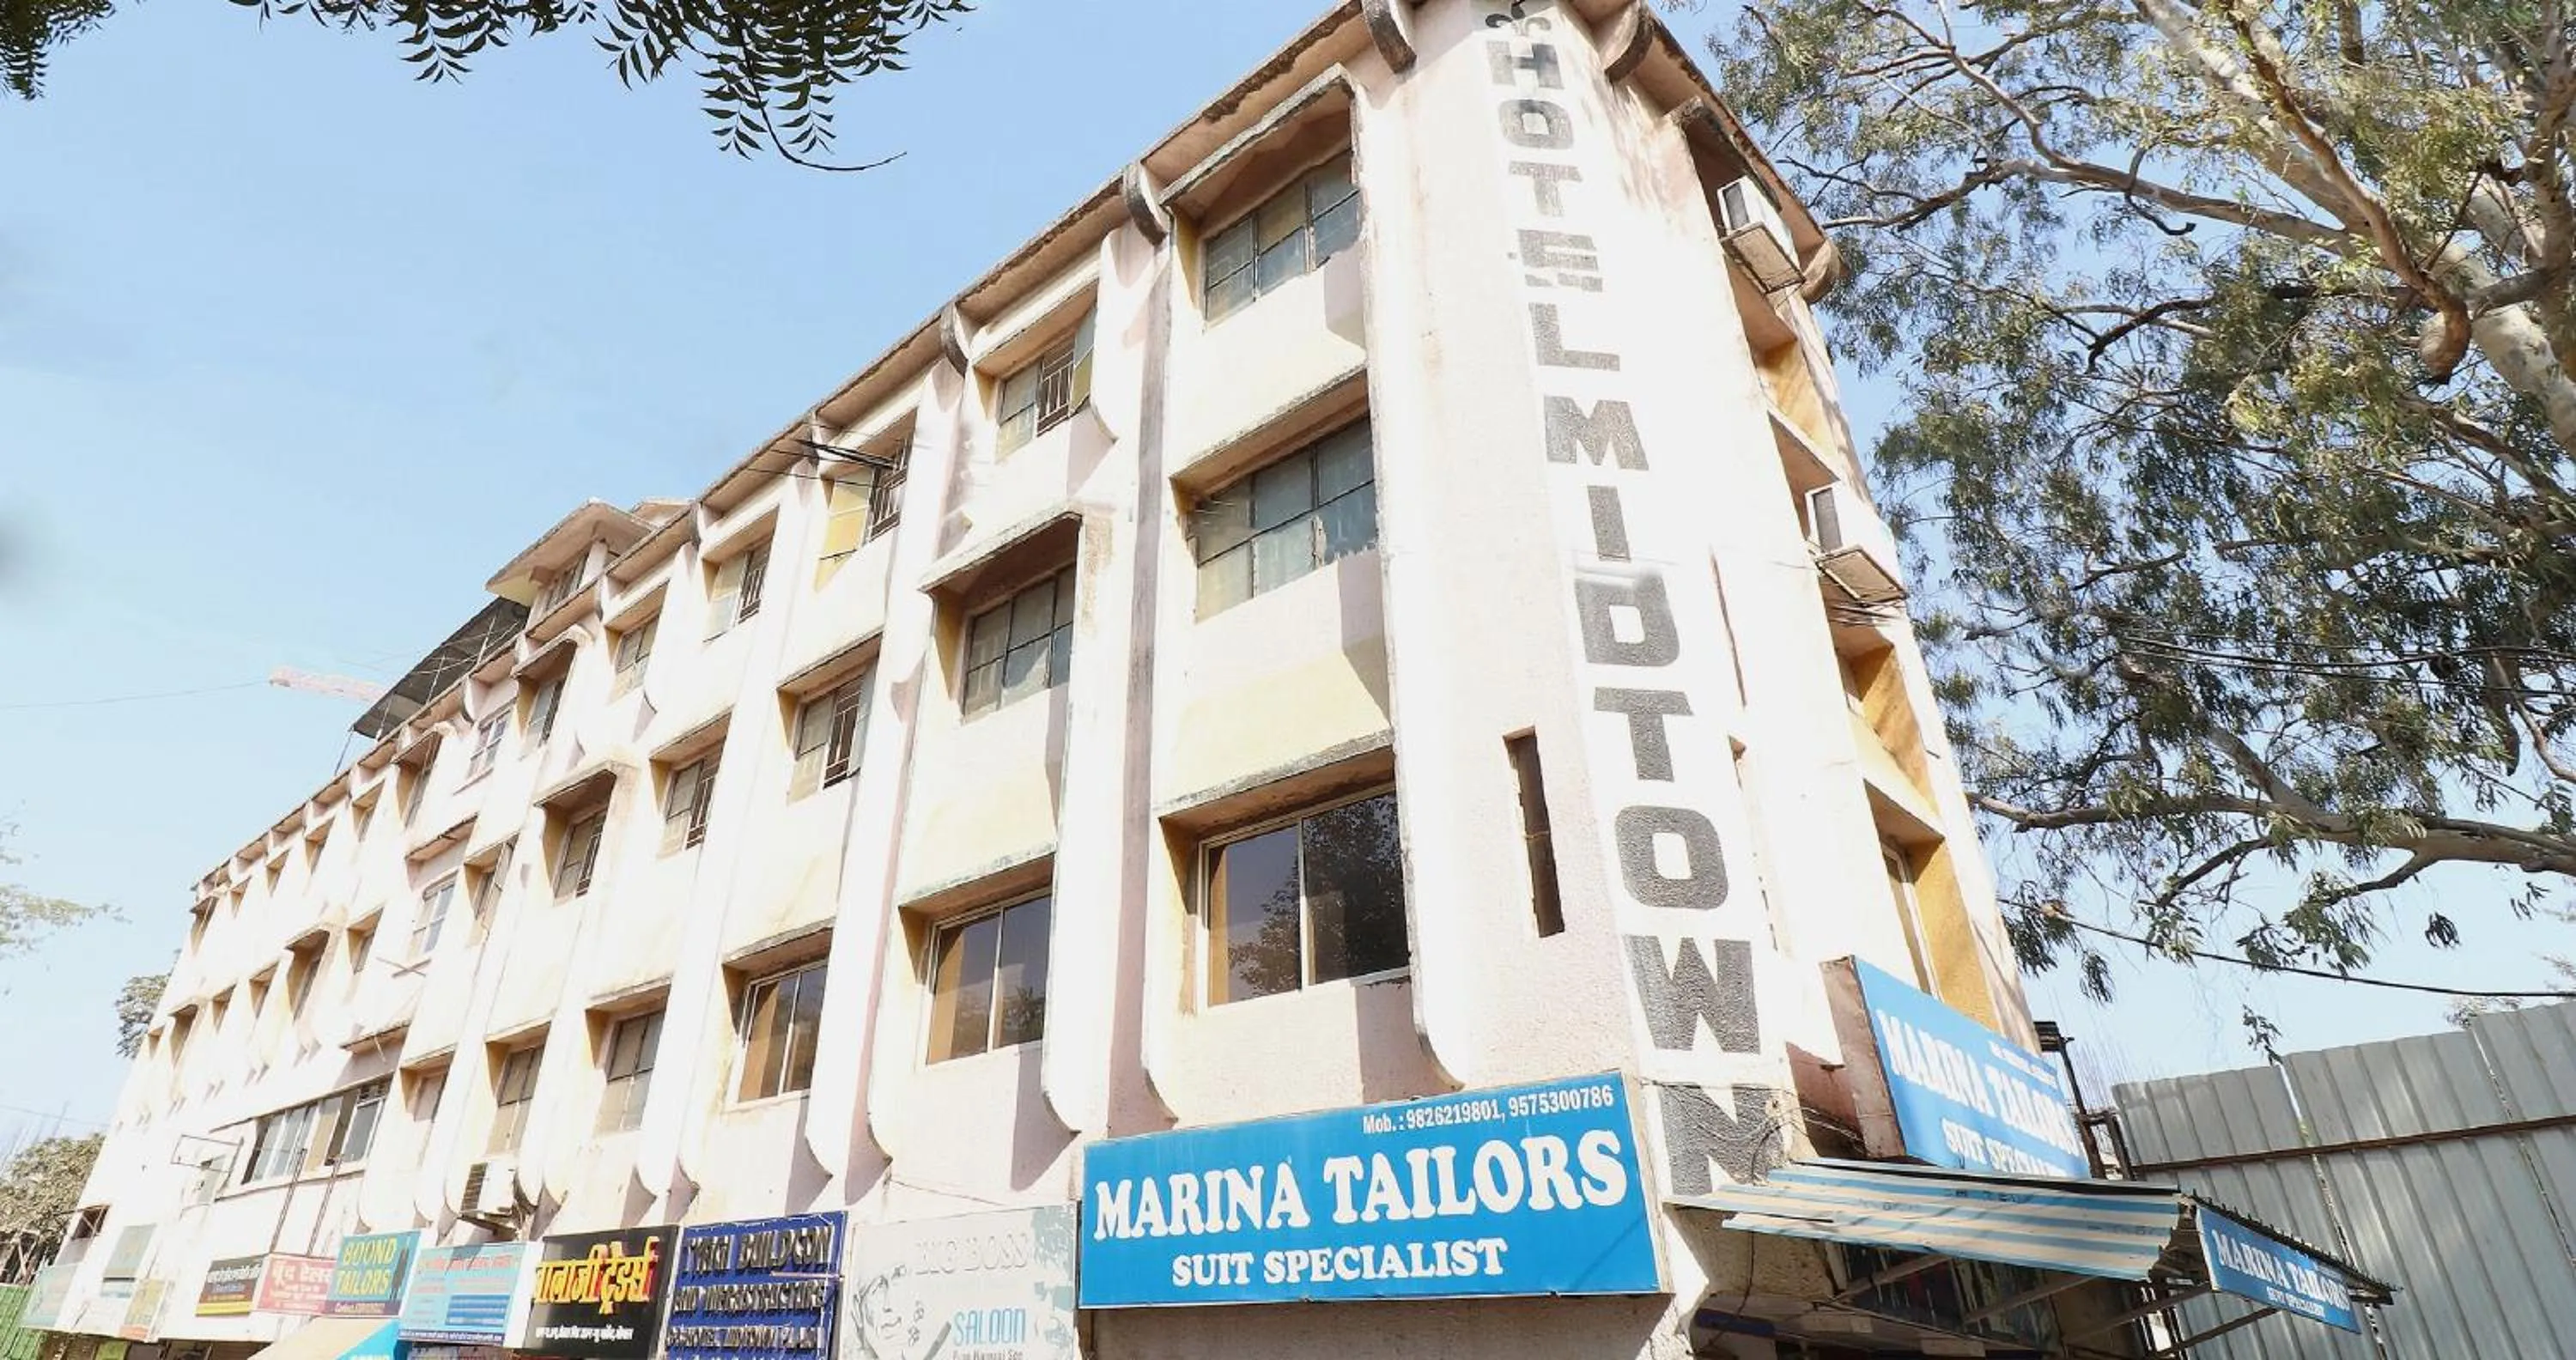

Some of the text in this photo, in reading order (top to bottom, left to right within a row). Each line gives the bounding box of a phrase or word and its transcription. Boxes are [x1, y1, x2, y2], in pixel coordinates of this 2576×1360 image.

[1485, 39, 1783, 1197] HOTEL MIDTOWN
[1509, 1084, 1614, 1118] 9575300786
[1875, 1008, 1996, 1118] MARINA
[1984, 1063, 2081, 1157] TAILORS
[1093, 1129, 1627, 1241] MARINA TAILORS
[1172, 1237, 1508, 1287] SUIT SPECIALIST
[2211, 1229, 2351, 1311] MARINA TAILORS
[953, 1307, 1026, 1347] SALOON
